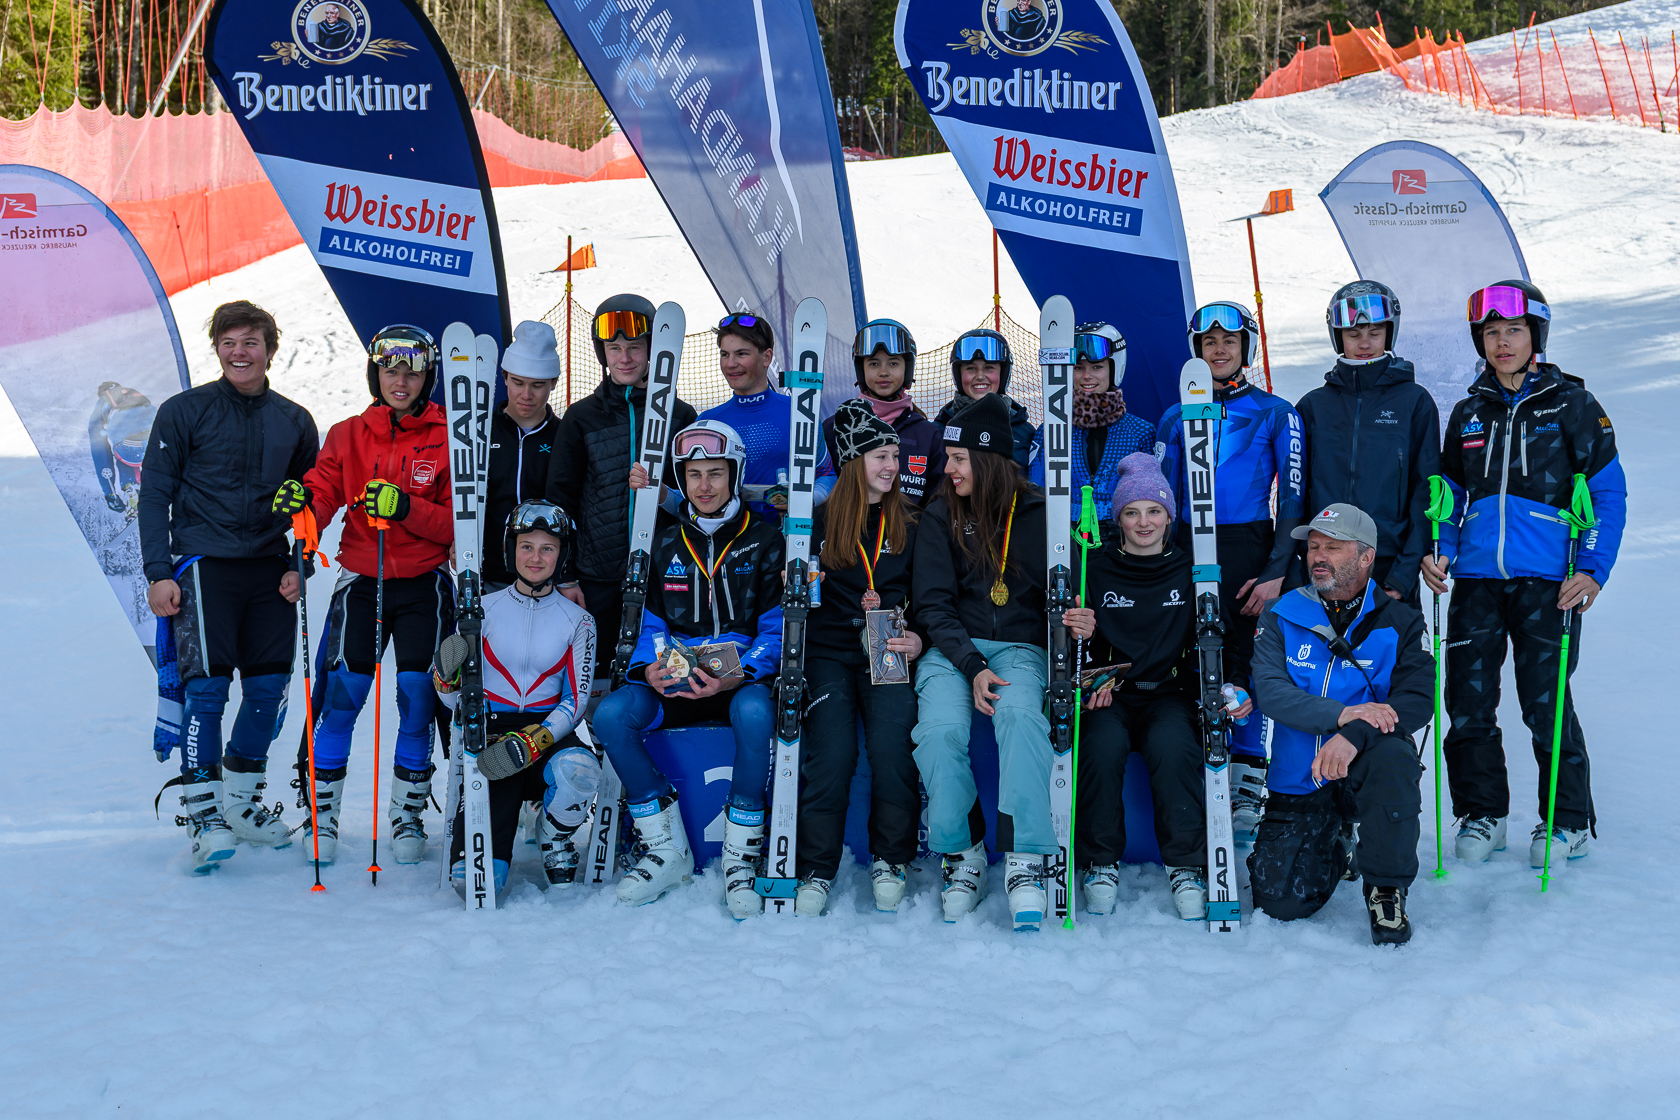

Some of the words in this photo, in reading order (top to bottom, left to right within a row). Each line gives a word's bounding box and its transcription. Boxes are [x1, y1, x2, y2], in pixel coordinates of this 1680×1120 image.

[232, 71, 432, 120] Benediktiner
[921, 60, 1122, 113] Benediktiner
[993, 135, 1149, 199] Weissbier
[324, 181, 476, 242] Weissbier
[996, 191, 1131, 229] ALKOHOLFREI
[328, 235, 461, 270] ALKOHOLFREI
[643, 350, 675, 487] HEAD
[1462, 422, 1485, 435] ASV
[451, 374, 477, 521] HEAD
[1287, 412, 1303, 497] ziener
[666, 566, 687, 576] ASV
[579, 643, 595, 696] Schöffel
[1286, 655, 1316, 670] Husqvarna
[187, 715, 201, 770] ziener
[732, 812, 761, 821] HEAD
[472, 832, 487, 910] HEAD
[592, 806, 613, 884] HEAD
